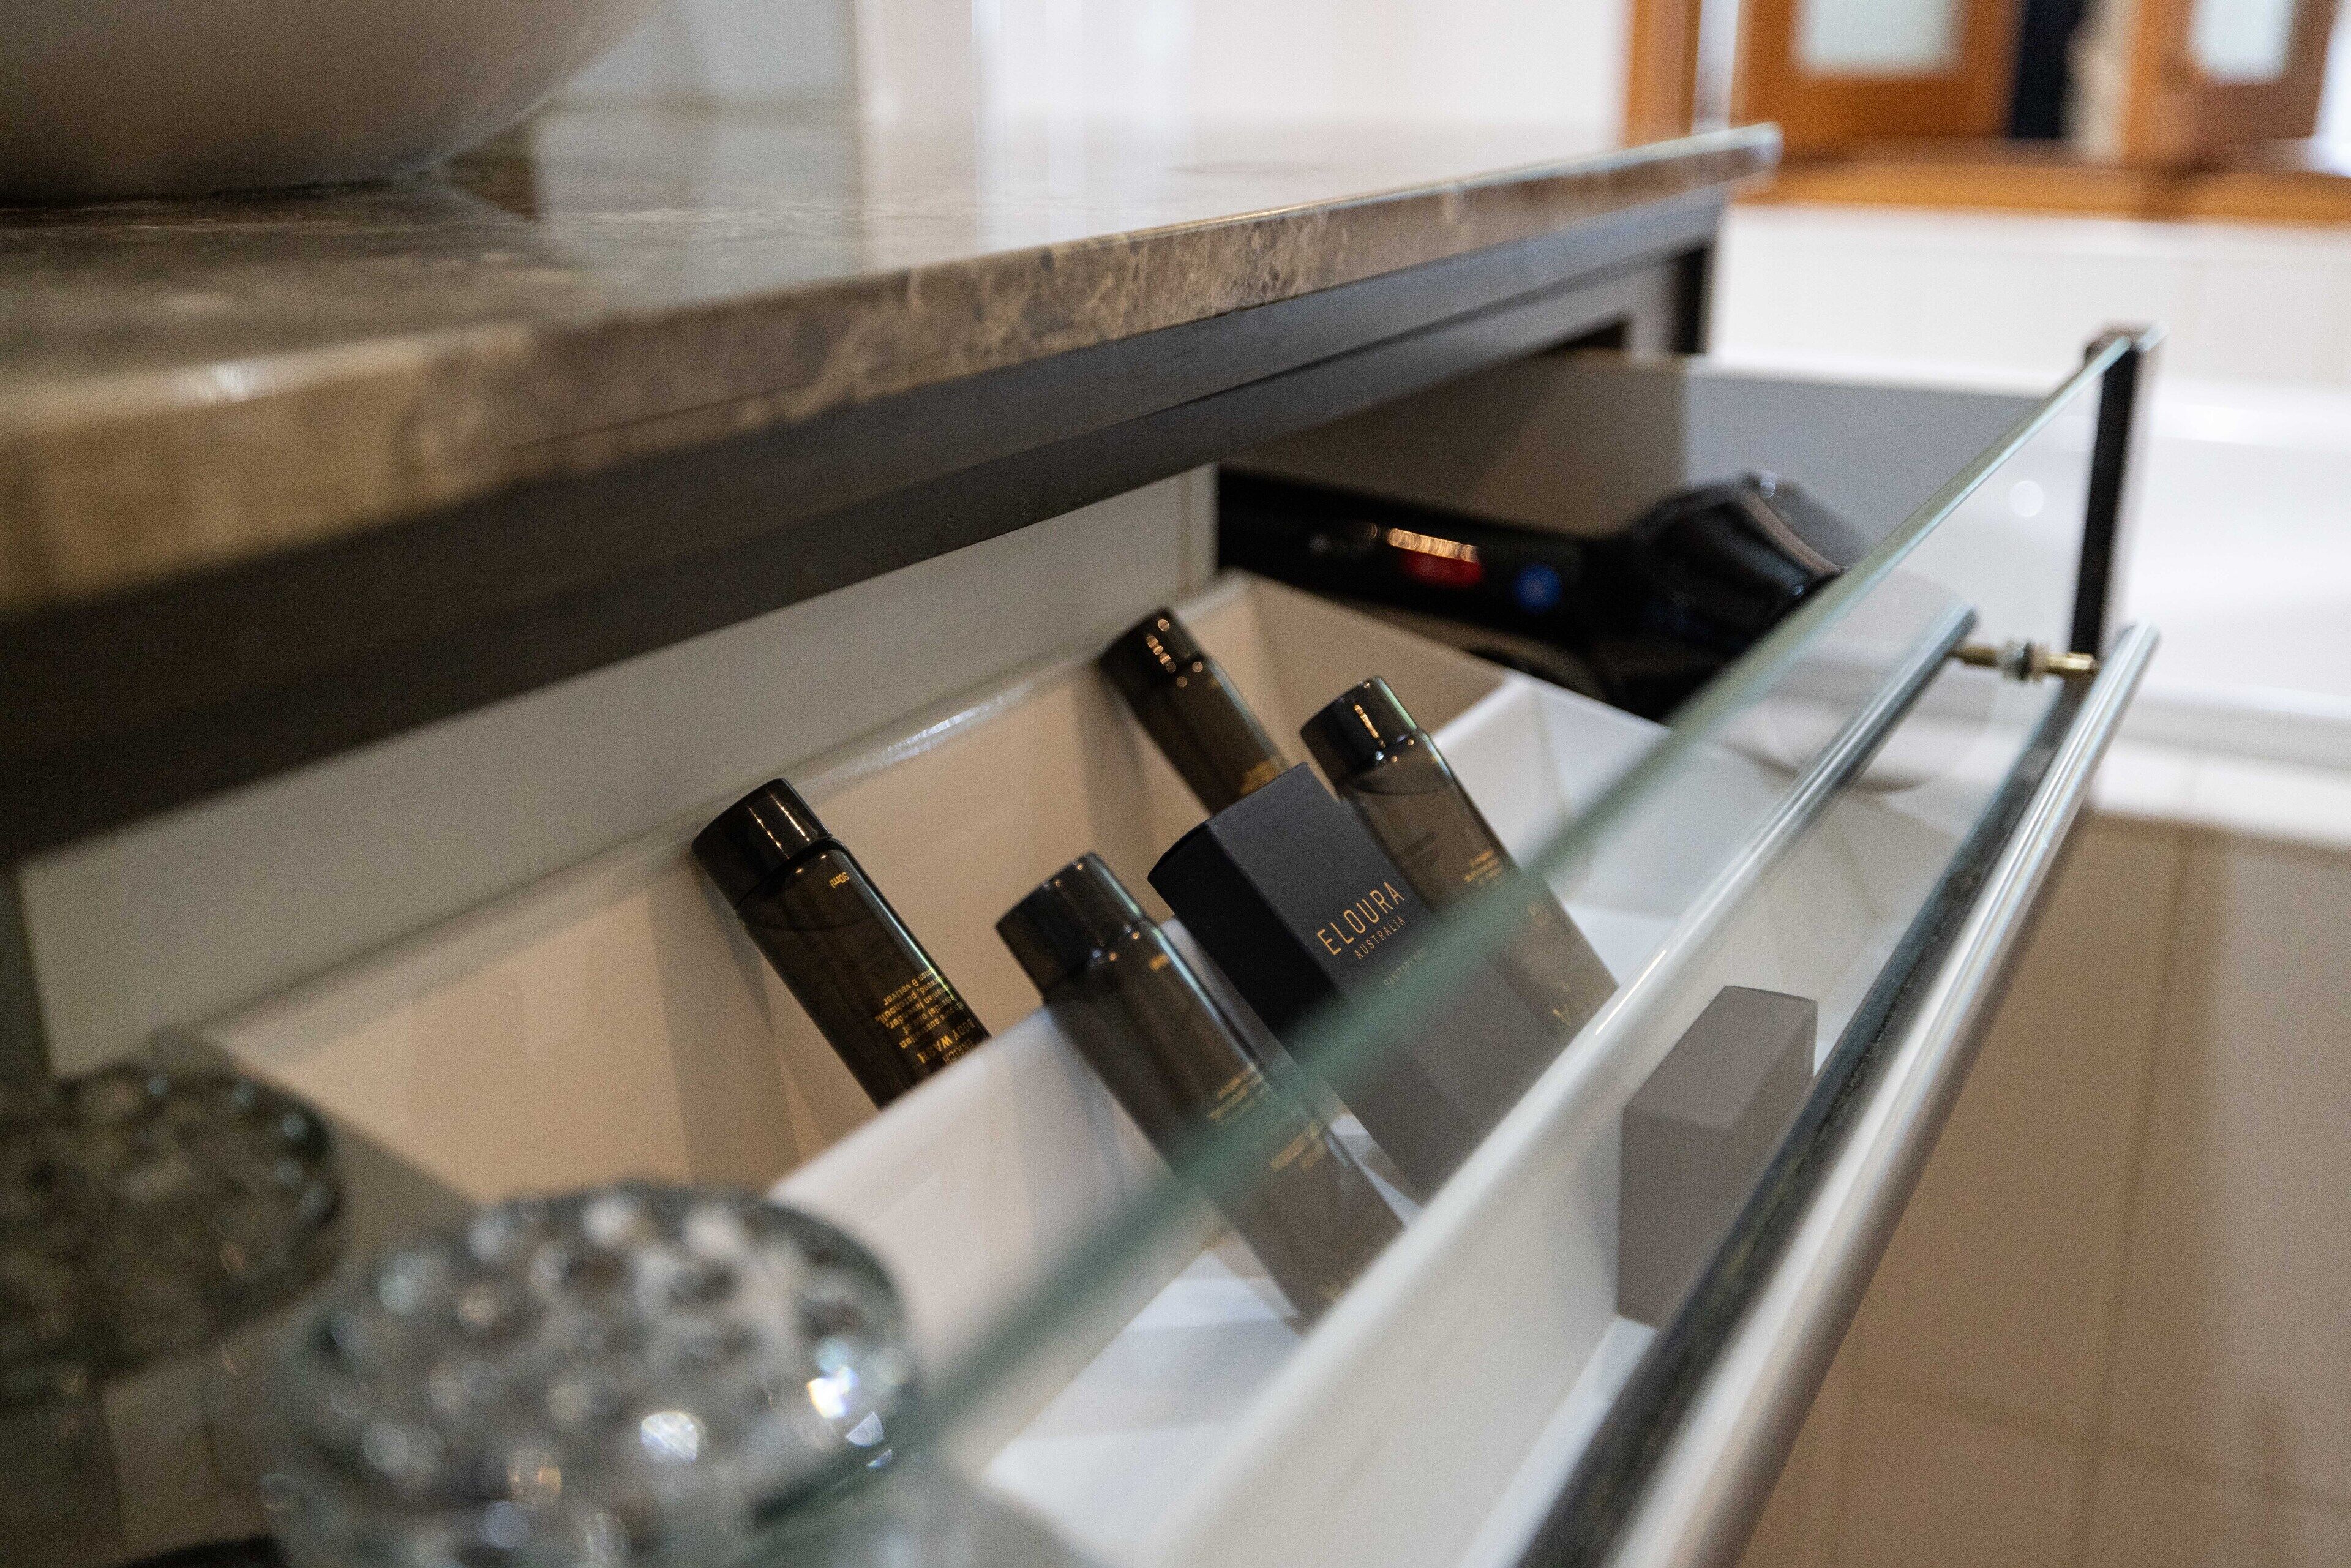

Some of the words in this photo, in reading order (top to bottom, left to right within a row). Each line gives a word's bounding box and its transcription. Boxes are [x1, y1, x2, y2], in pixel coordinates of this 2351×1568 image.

[829, 871, 850, 889] 30ml
[1317, 882, 1405, 955] ELOURA
[1355, 915, 1406, 959] AUSTRALIA
[911, 978, 918, 987] &
[883, 983, 911, 1006] vetiver
[928, 994, 954, 1016] essential
[951, 1018, 975, 1040] BODY
[917, 1035, 953, 1063] WASH
